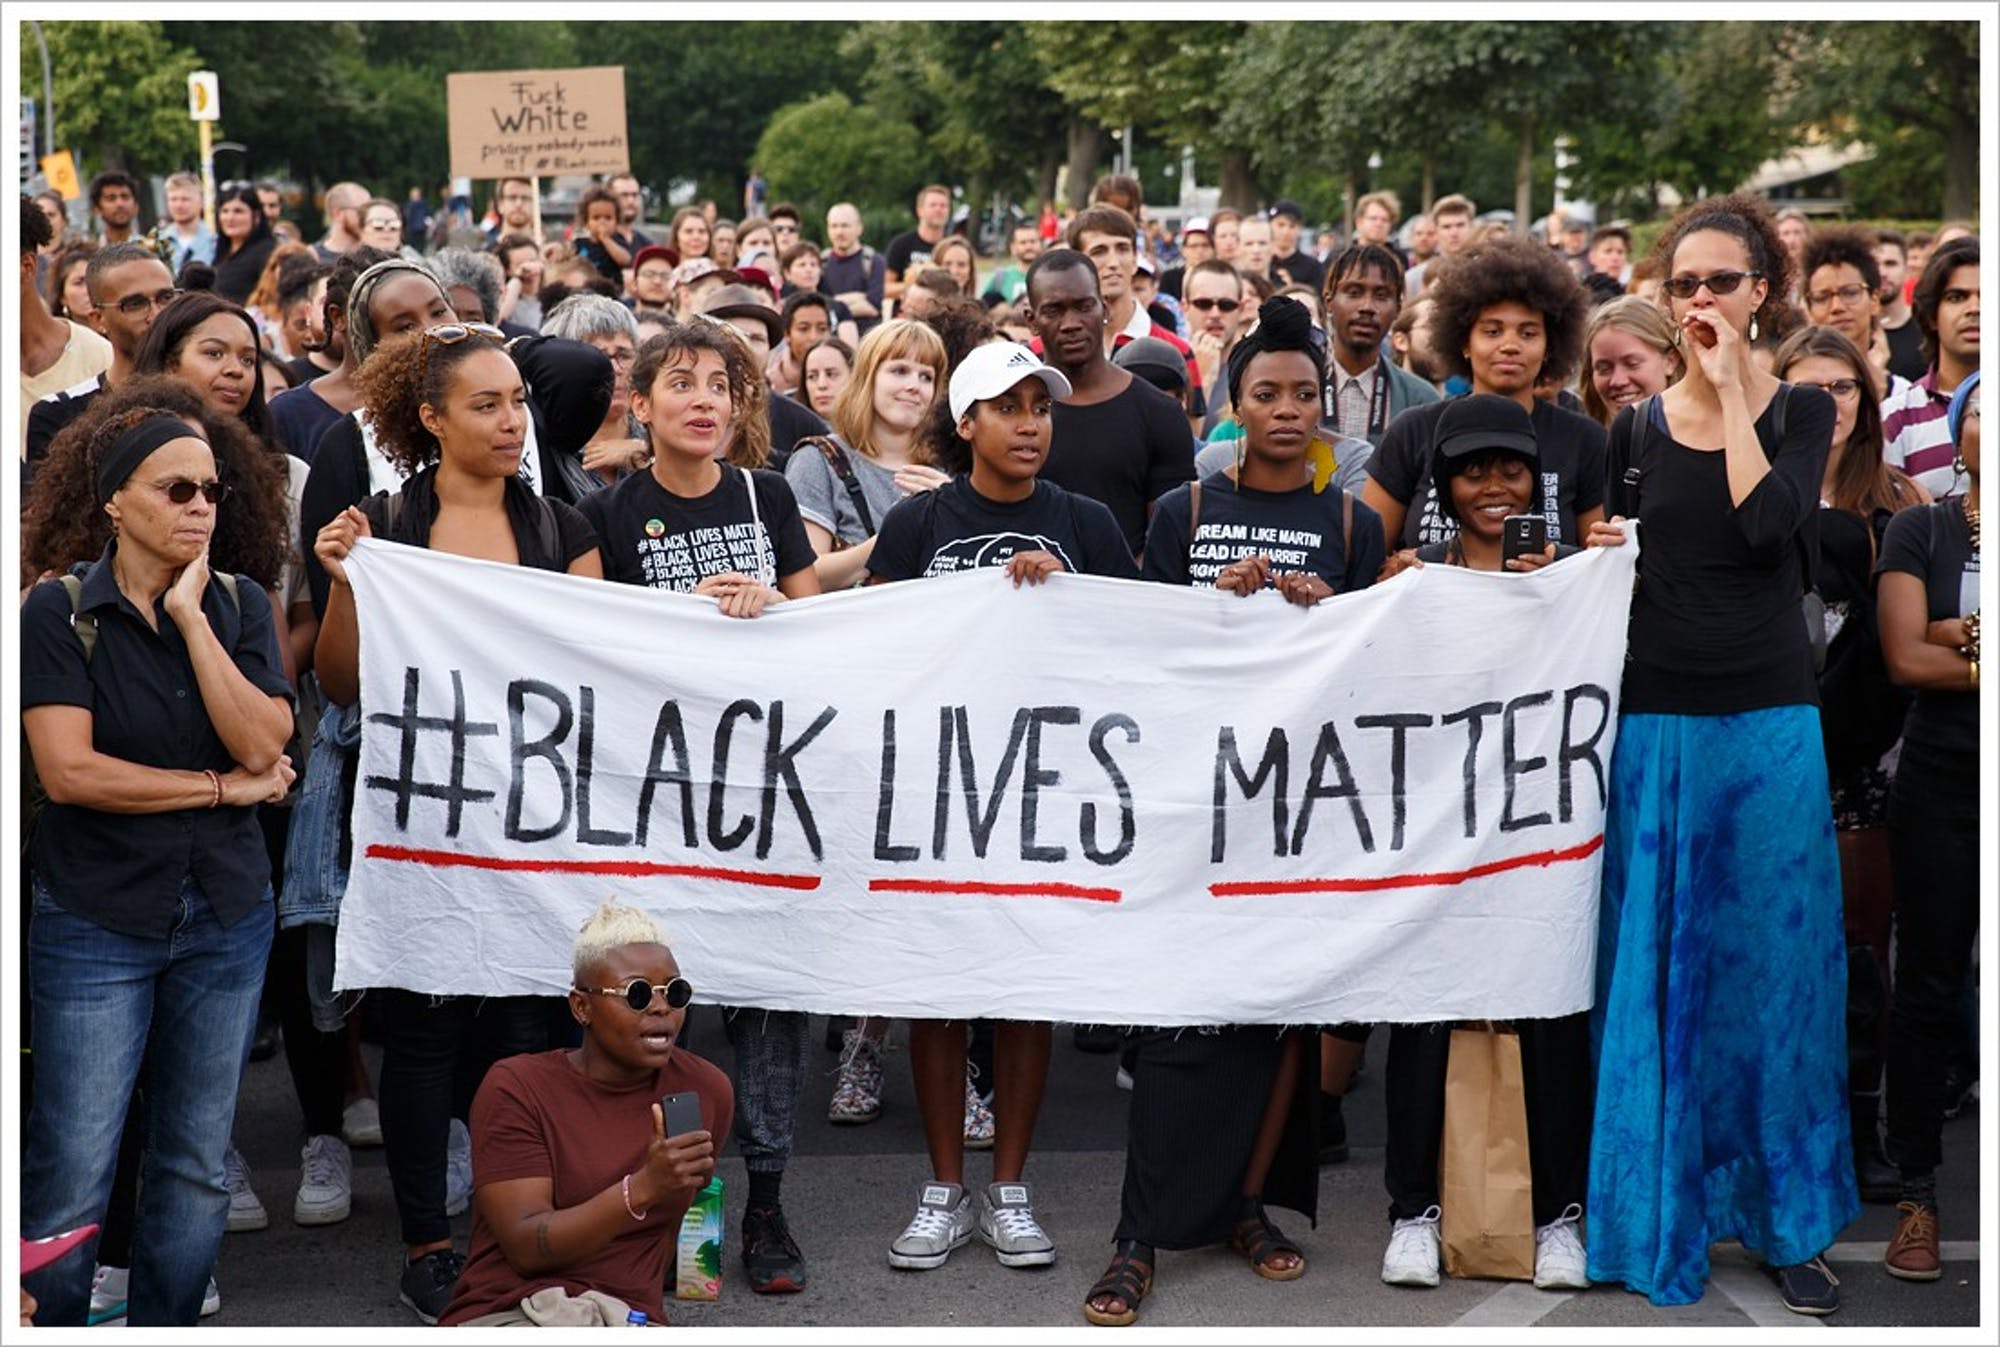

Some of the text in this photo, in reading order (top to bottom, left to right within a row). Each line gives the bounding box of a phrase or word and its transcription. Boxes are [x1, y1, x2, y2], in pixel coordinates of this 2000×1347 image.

[509, 80, 567, 104] Fuck
[491, 105, 588, 133] White
[637, 521, 767, 555] #BLACK LIVES MATTR
[1251, 527, 1277, 542] LIKE
[1279, 530, 1322, 548] MARTIN
[641, 549, 693, 571] #BLACK
[693, 543, 729, 560] LIVES
[699, 559, 733, 575] LIVES
[1190, 545, 1308, 565] LEAD LIKE HARRIET
[365, 666, 1611, 866] #BLACK LIVES MATTER
